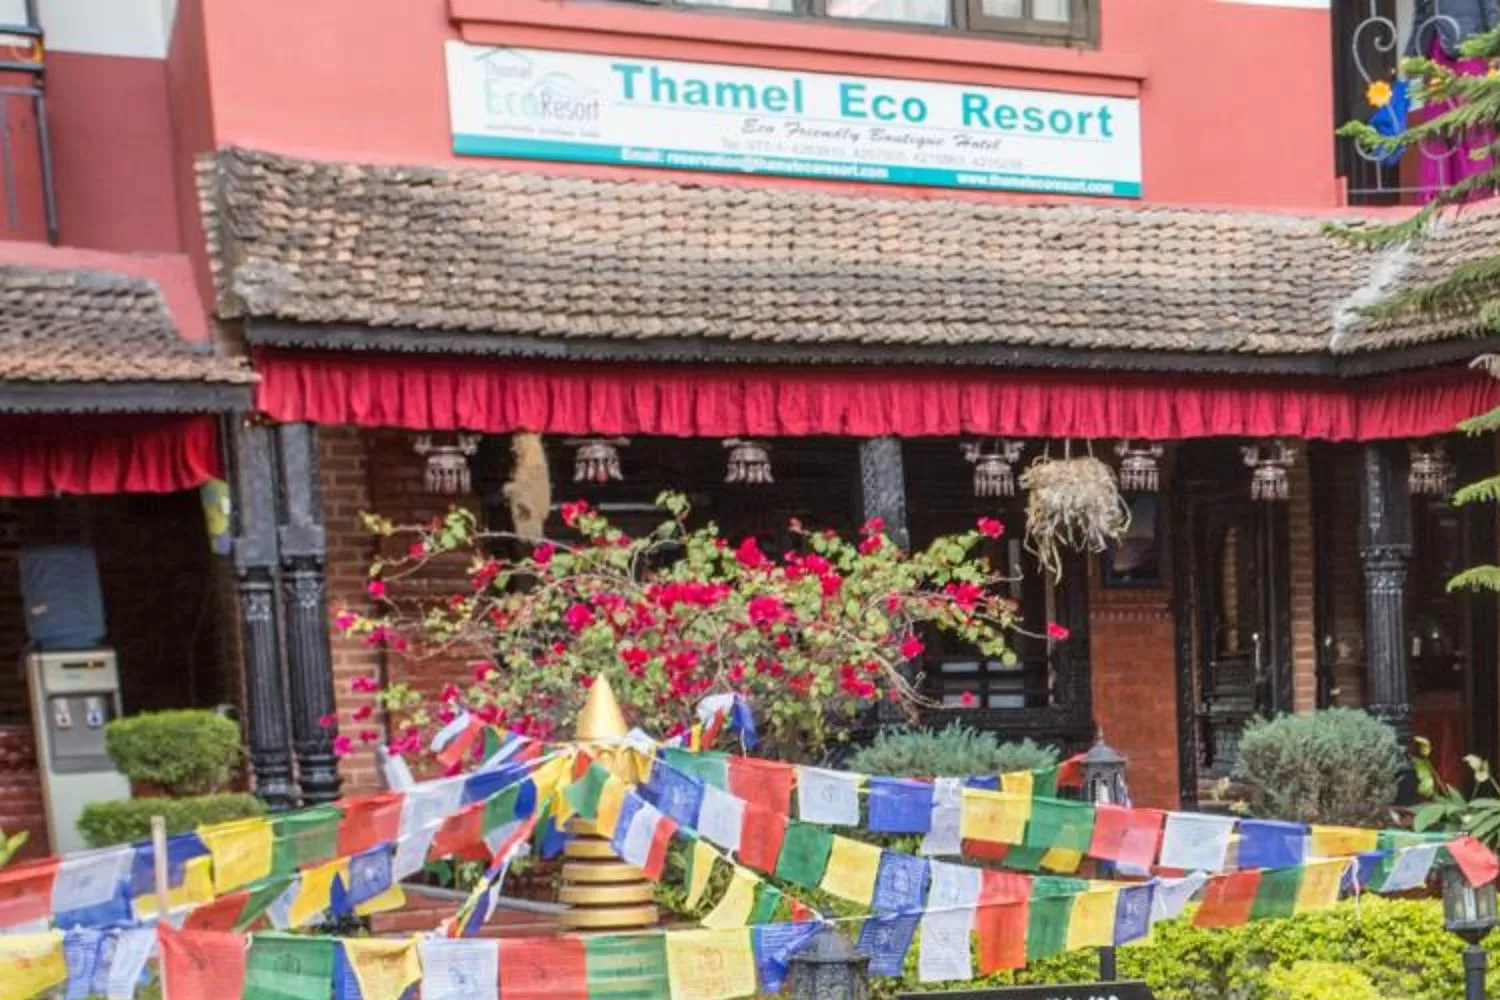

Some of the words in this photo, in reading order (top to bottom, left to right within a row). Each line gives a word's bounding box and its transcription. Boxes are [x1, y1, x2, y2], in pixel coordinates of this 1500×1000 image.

[611, 64, 803, 113] Thamel
[839, 82, 928, 123] Eco
[962, 92, 1114, 137] Resort
[741, 117, 775, 134] Eco
[784, 121, 860, 144] Friendly
